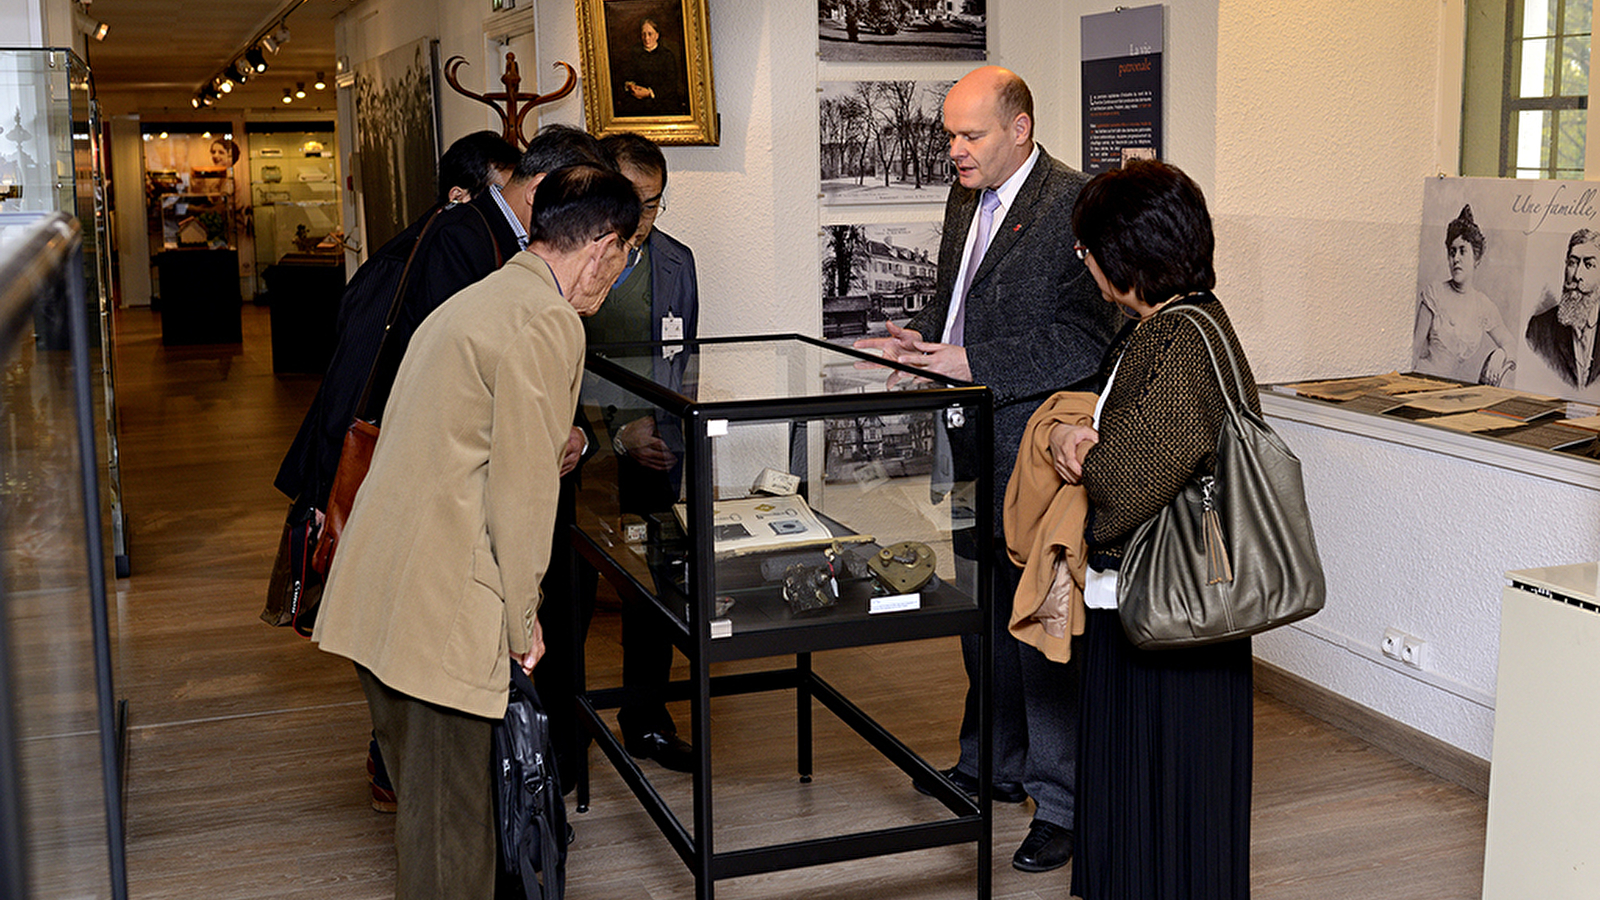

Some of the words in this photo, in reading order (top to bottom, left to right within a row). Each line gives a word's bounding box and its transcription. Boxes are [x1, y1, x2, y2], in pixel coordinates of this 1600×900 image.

[1130, 44, 1139, 56] La
[1140, 42, 1151, 54] vie
[1118, 57, 1152, 77] patronale
[1512, 194, 1541, 214] Une
[1523, 184, 1598, 236] famille,
[291, 580, 301, 614] Canon
